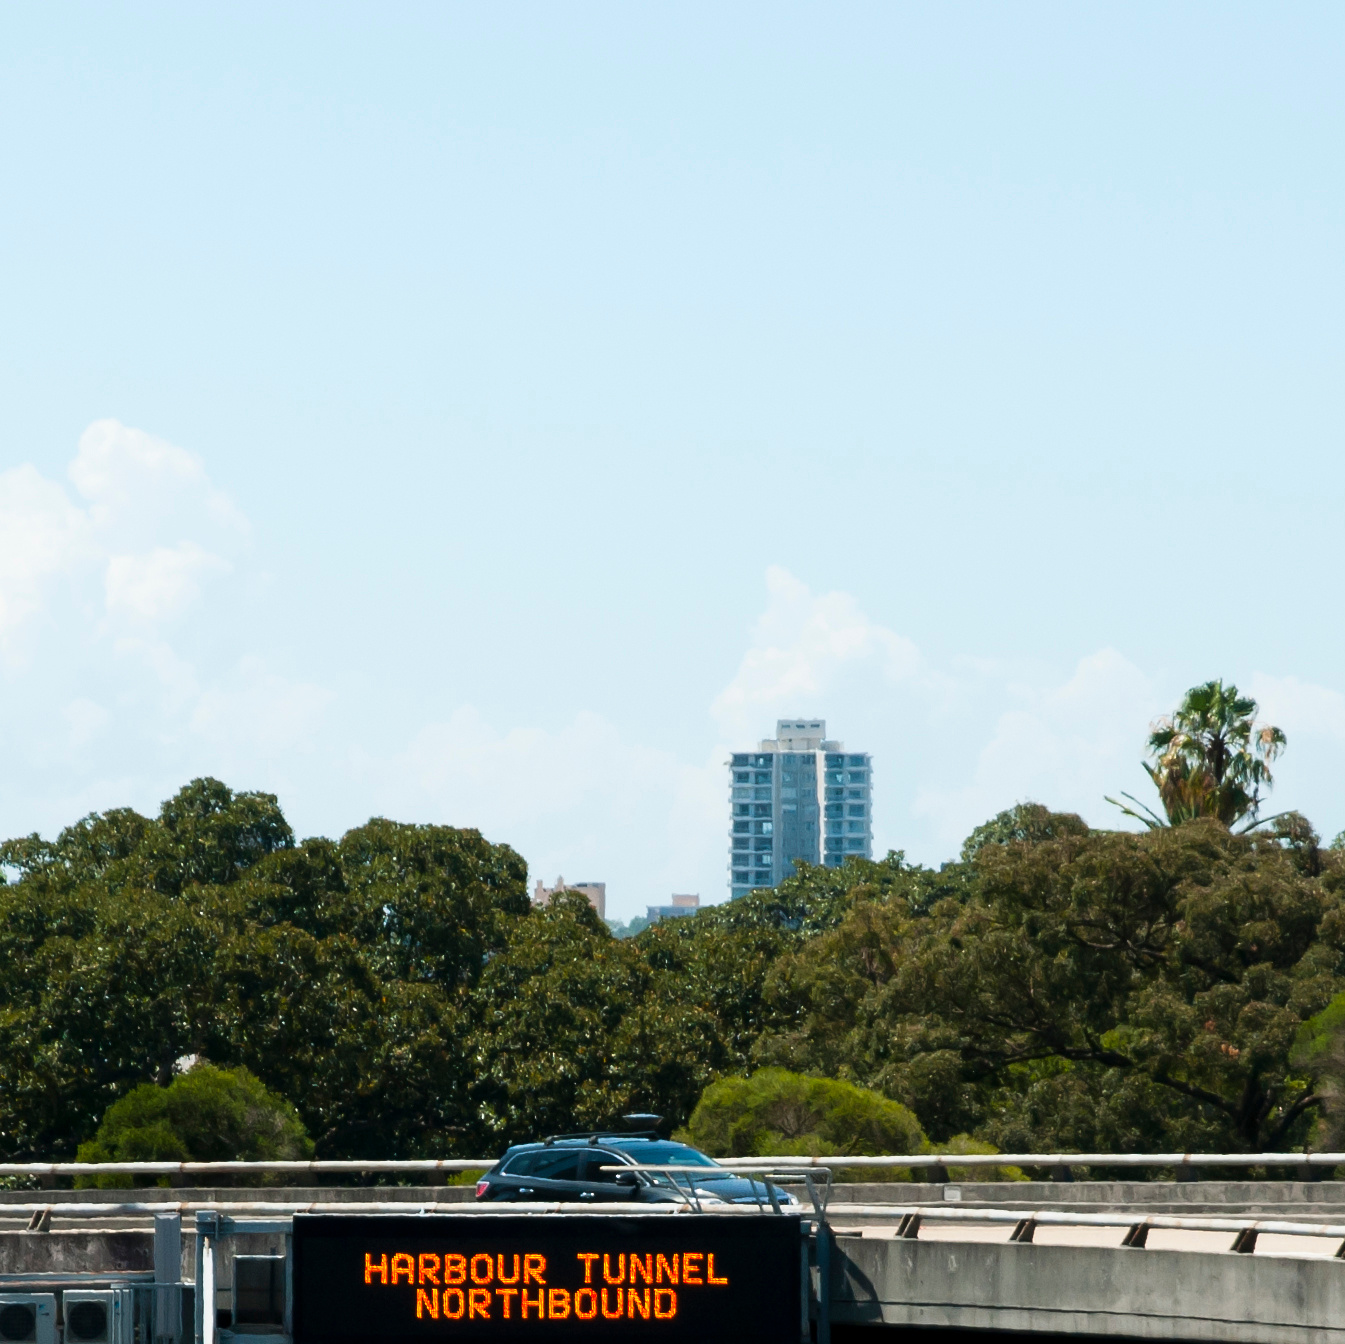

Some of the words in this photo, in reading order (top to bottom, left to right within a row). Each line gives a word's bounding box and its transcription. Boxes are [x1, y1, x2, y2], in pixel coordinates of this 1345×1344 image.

[364, 1252, 547, 1285] HARBOUR
[576, 1252, 729, 1285] TUNNEL
[415, 1287, 678, 1320] NORTHBOUND
